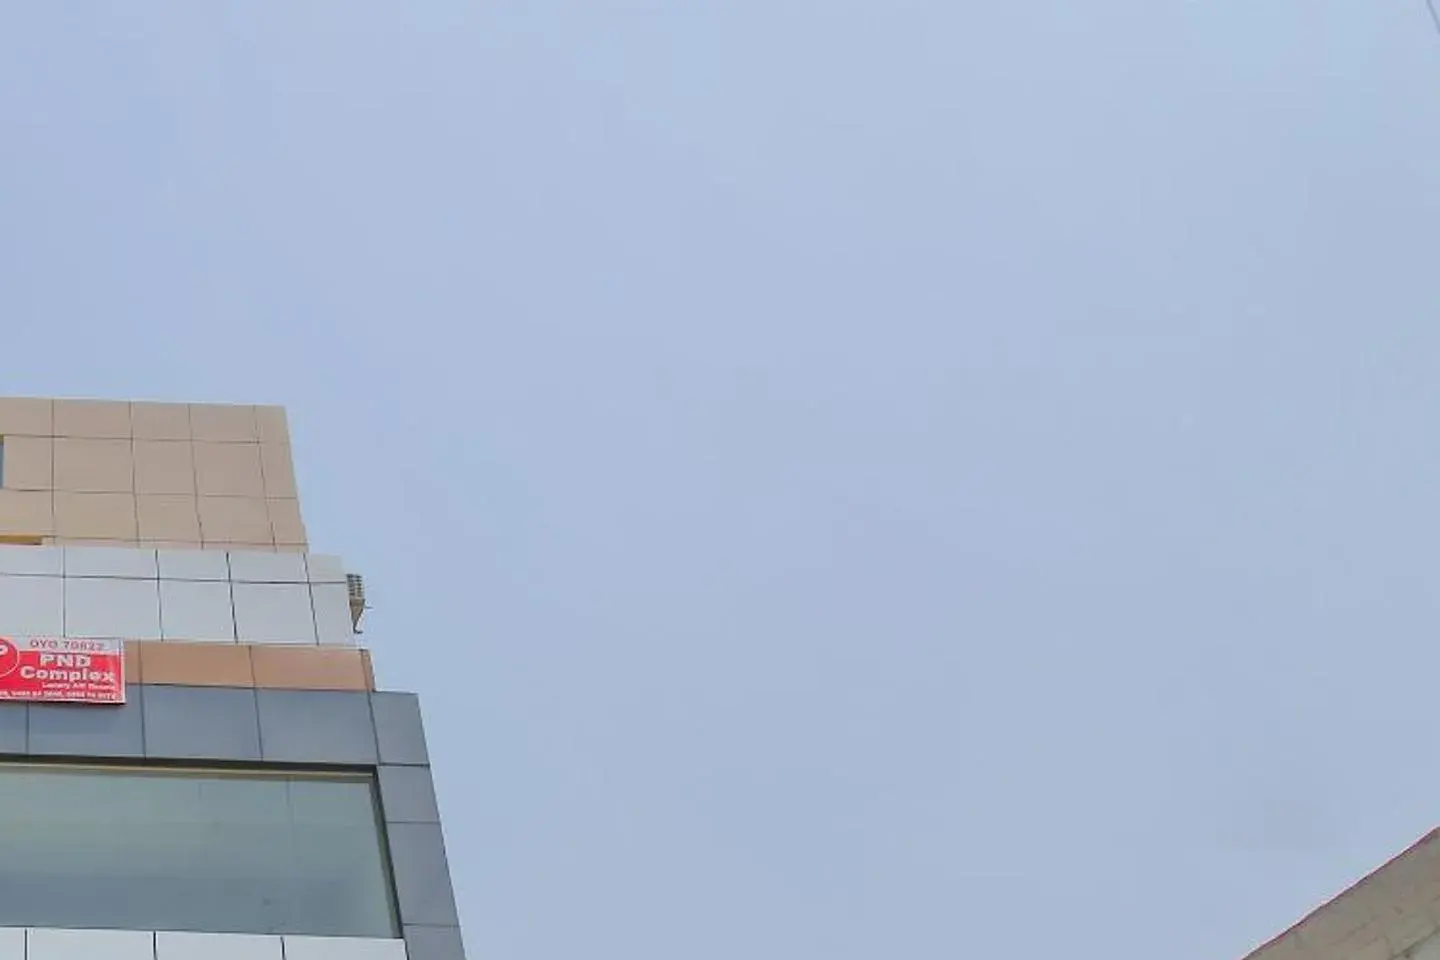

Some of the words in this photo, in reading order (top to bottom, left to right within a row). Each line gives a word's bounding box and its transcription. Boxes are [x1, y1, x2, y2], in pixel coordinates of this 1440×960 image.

[30, 639, 58, 649] OYO
[39, 653, 92, 668] PND
[20, 665, 116, 684] Complex
